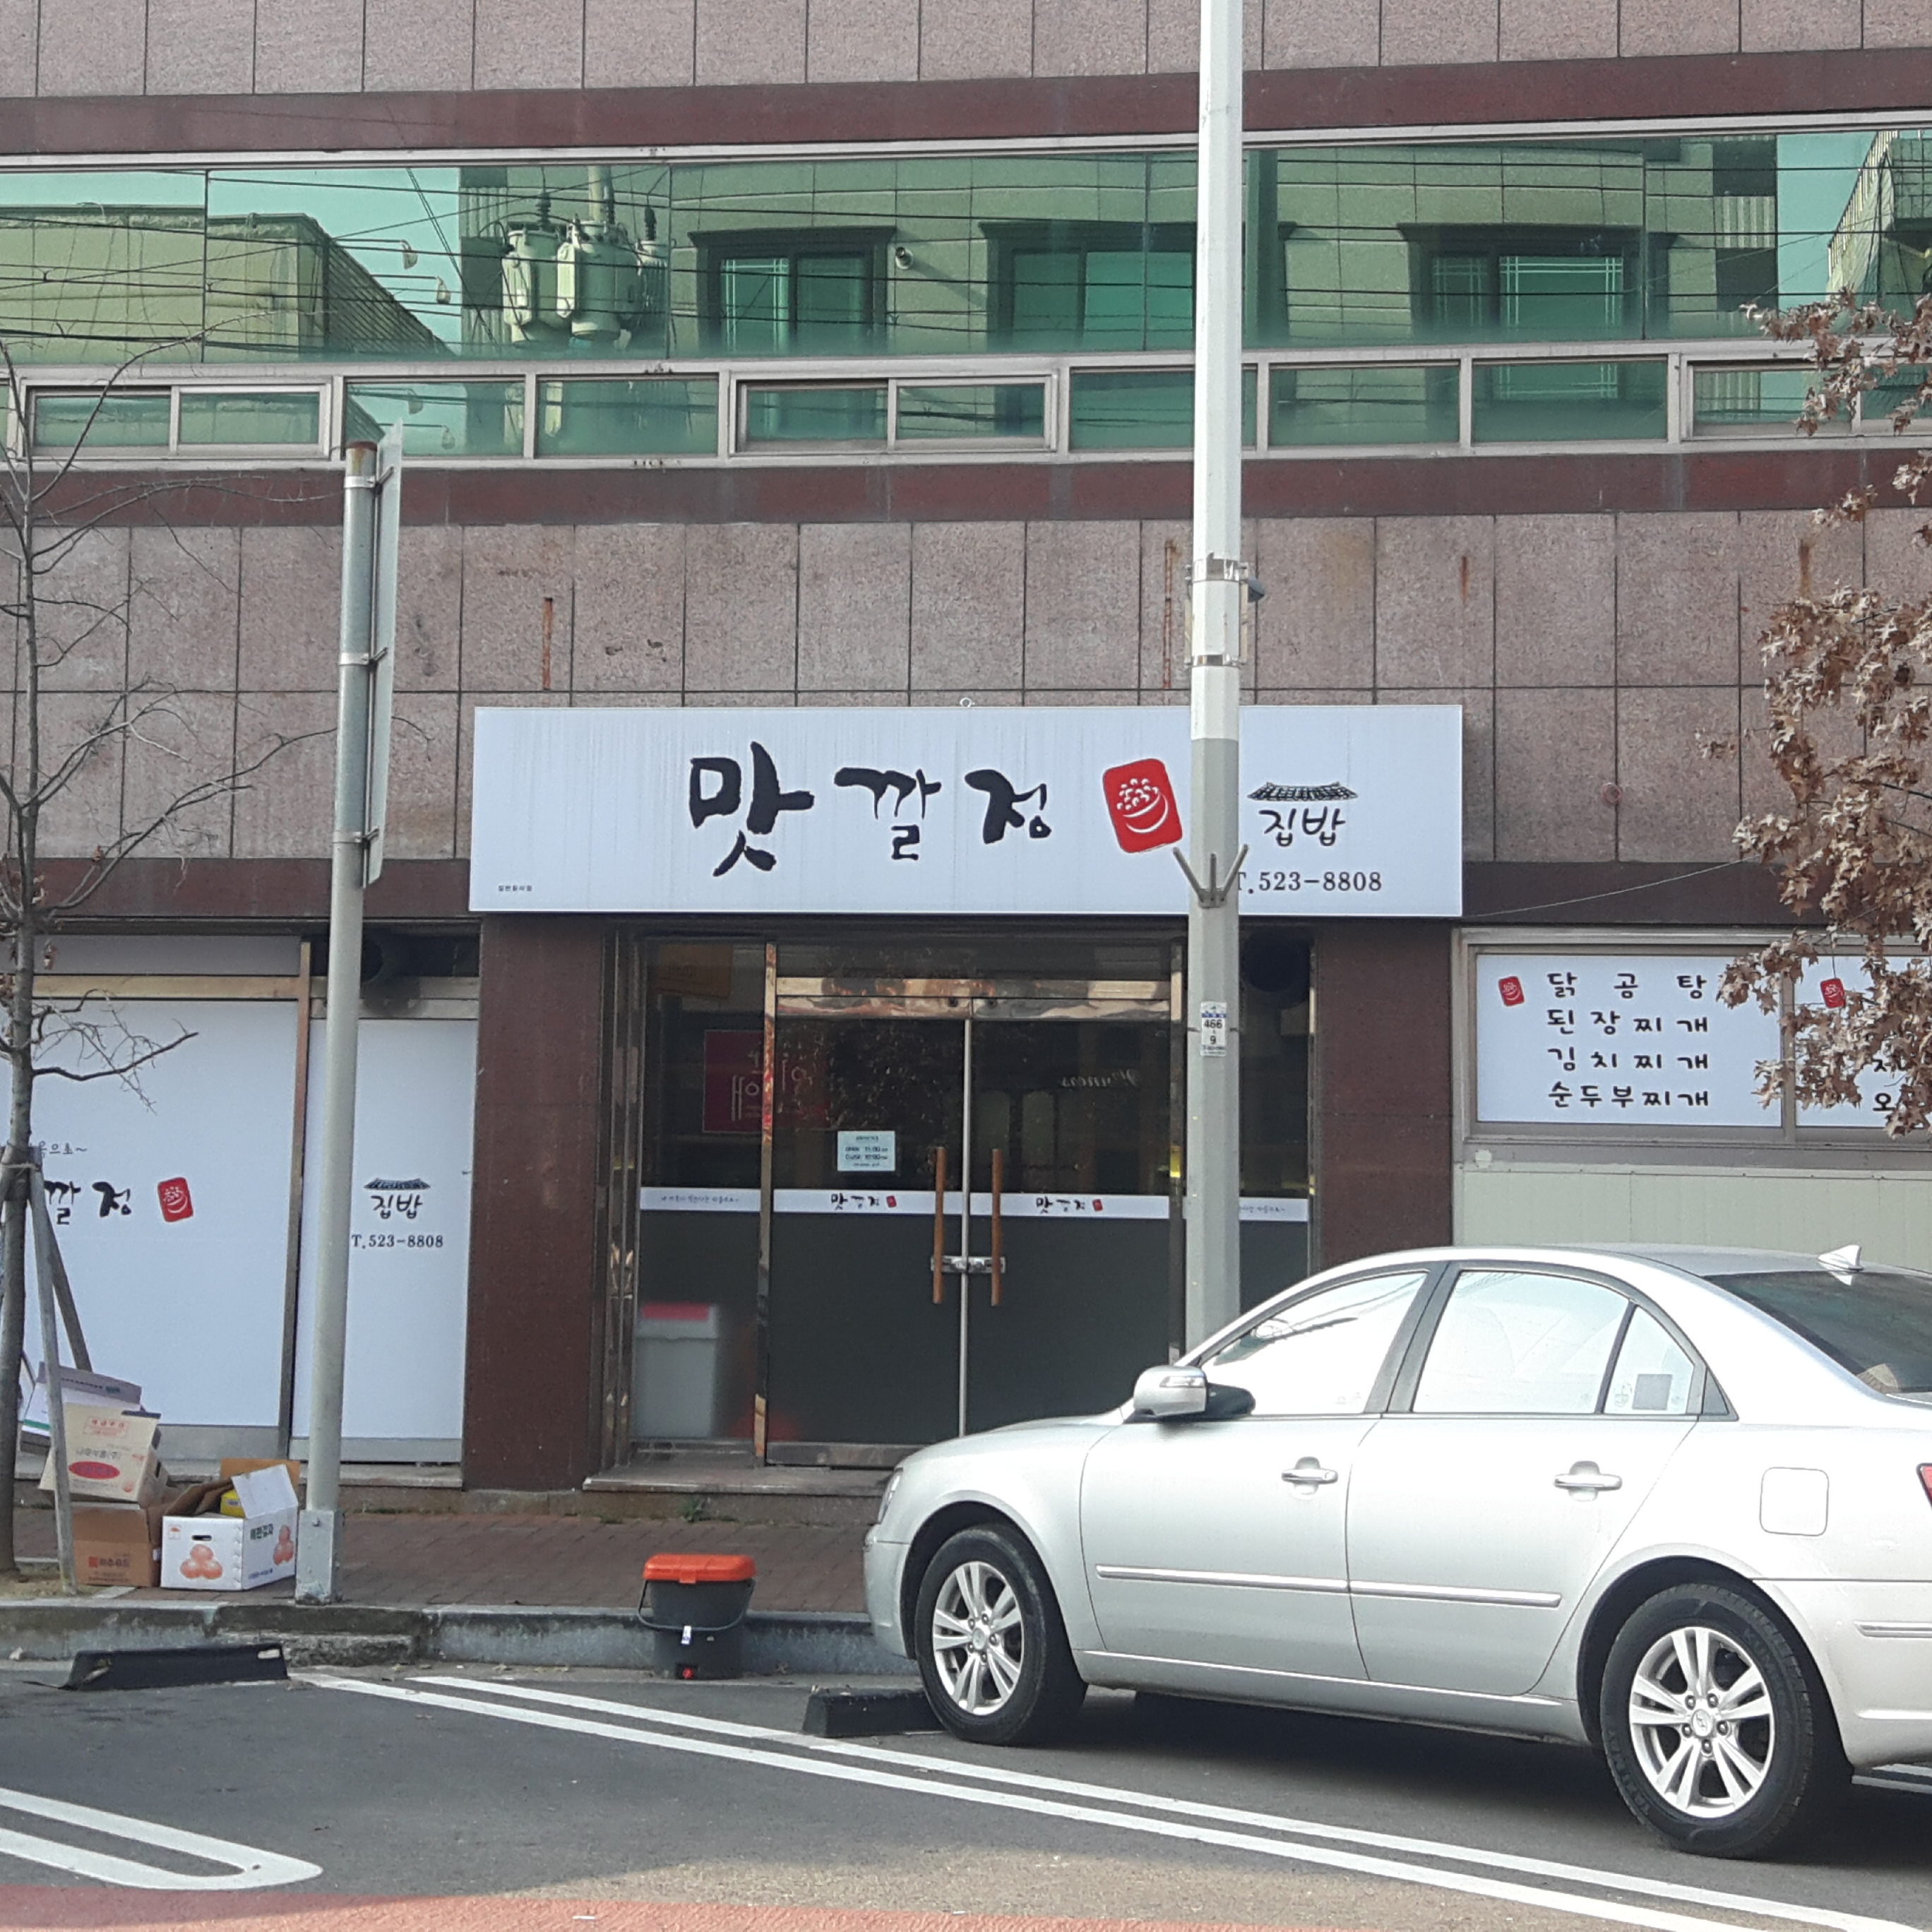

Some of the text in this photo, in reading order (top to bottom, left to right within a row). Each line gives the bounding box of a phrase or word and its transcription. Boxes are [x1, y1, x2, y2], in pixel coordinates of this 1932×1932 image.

[1258, 806, 1347, 847] 집밥
[1546, 1009, 1708, 1035] 된장찌개
[1546, 1046, 1708, 1072] 김치찌개
[1547, 1080, 1709, 1108] 순두부찌개
[371, 1193, 424, 1220] 집밥
[352, 1234, 443, 1249] T.523-8808
